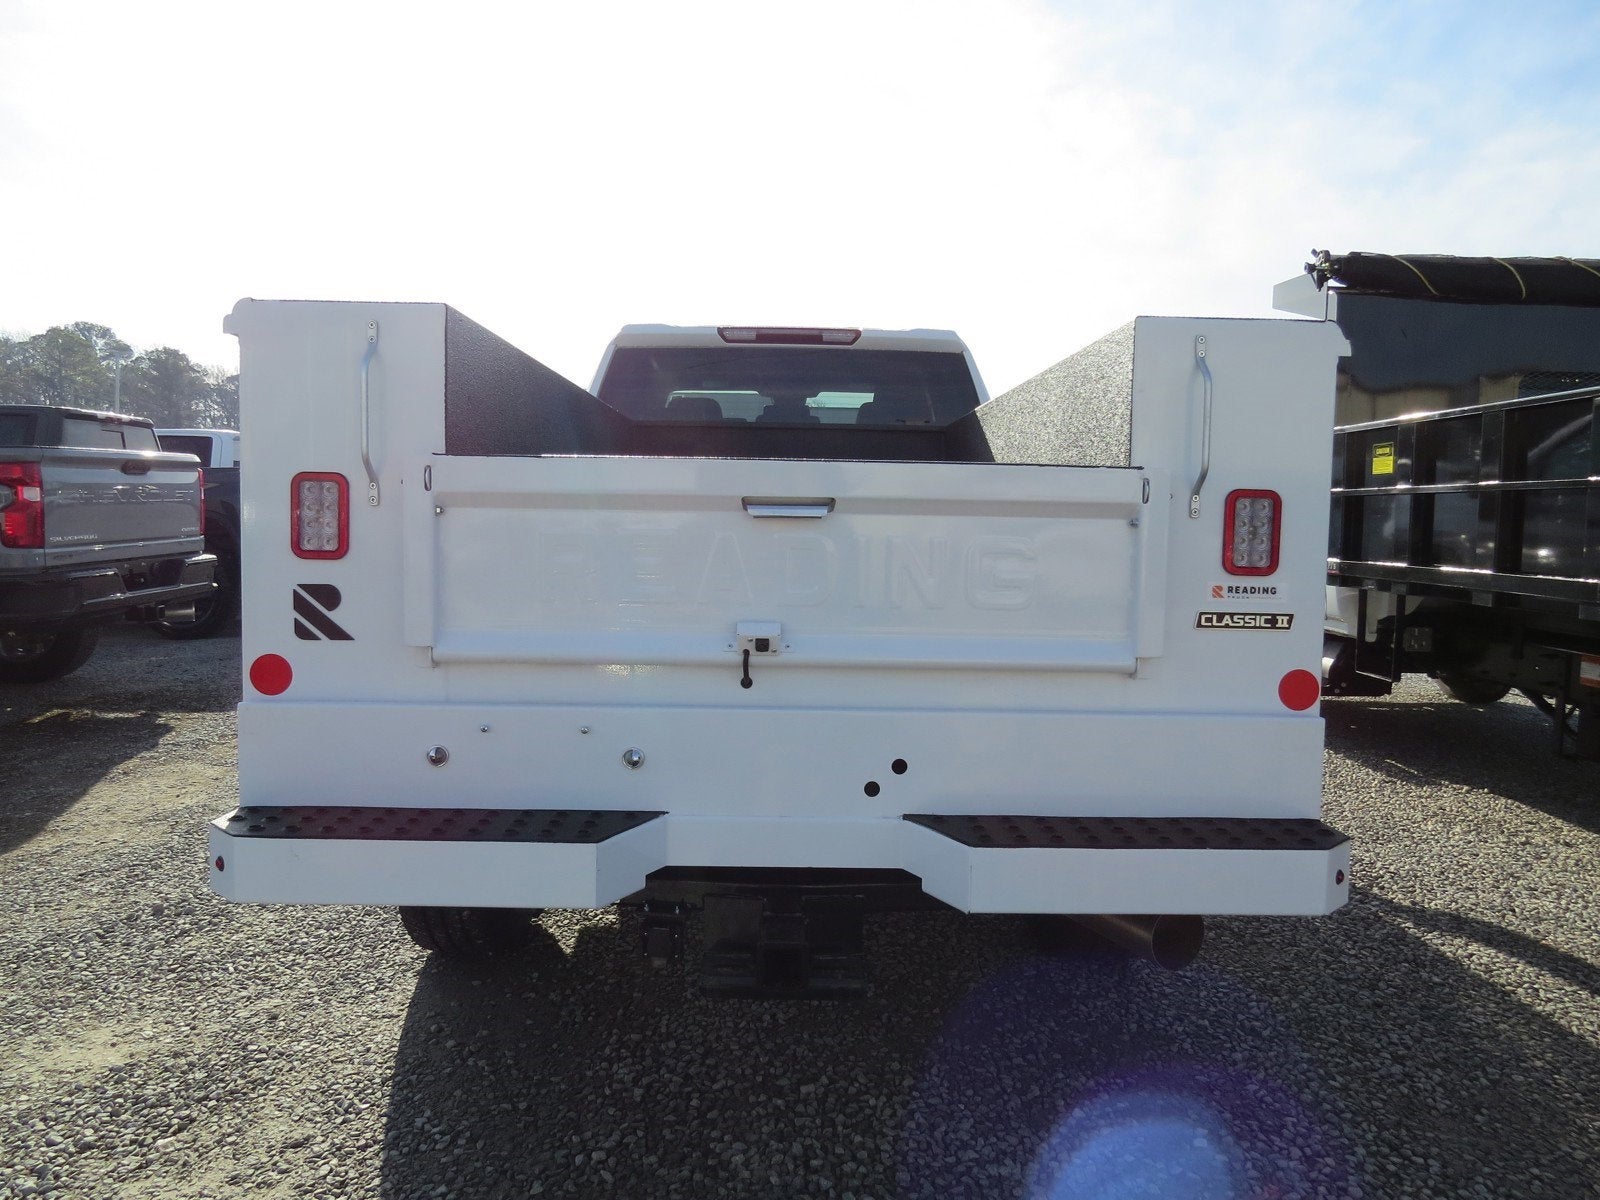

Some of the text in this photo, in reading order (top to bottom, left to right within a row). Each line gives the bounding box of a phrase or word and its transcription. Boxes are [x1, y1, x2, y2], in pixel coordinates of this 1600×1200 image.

[539, 529, 1039, 610] READING
[1227, 585, 1277, 595] READING
[1200, 614, 1290, 628] CLASSIC II
